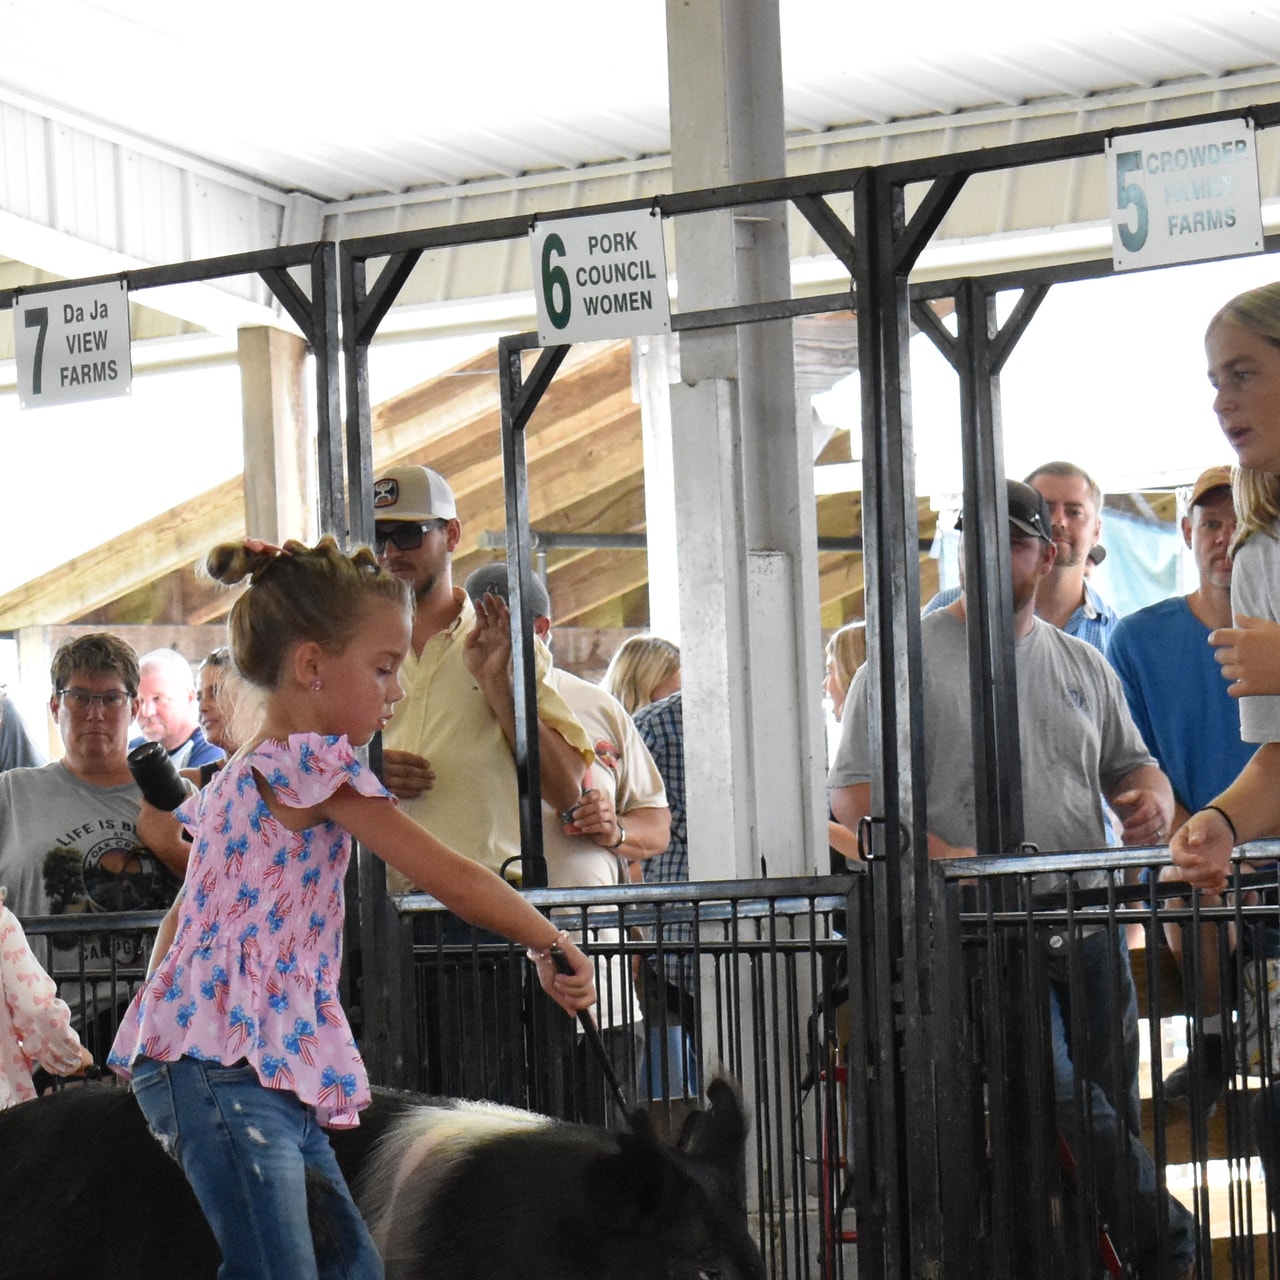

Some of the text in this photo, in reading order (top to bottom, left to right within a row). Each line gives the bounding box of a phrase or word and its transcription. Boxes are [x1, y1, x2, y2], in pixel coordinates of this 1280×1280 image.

[1116, 150, 1149, 253] 5
[1167, 207, 1237, 236] FARMS
[587, 231, 639, 256] PORK
[541, 232, 572, 330] 6
[575, 259, 657, 288] COUNCIL
[63, 299, 109, 325] Da Ja
[583, 290, 653, 317] WOMEN
[23, 306, 49, 395] 7
[65, 329, 108, 355] VIEW
[59, 359, 118, 388] FARMS
[55, 822, 95, 848] LIFE
[98, 818, 116, 831] IS
[91, 841, 112, 859] OAK
